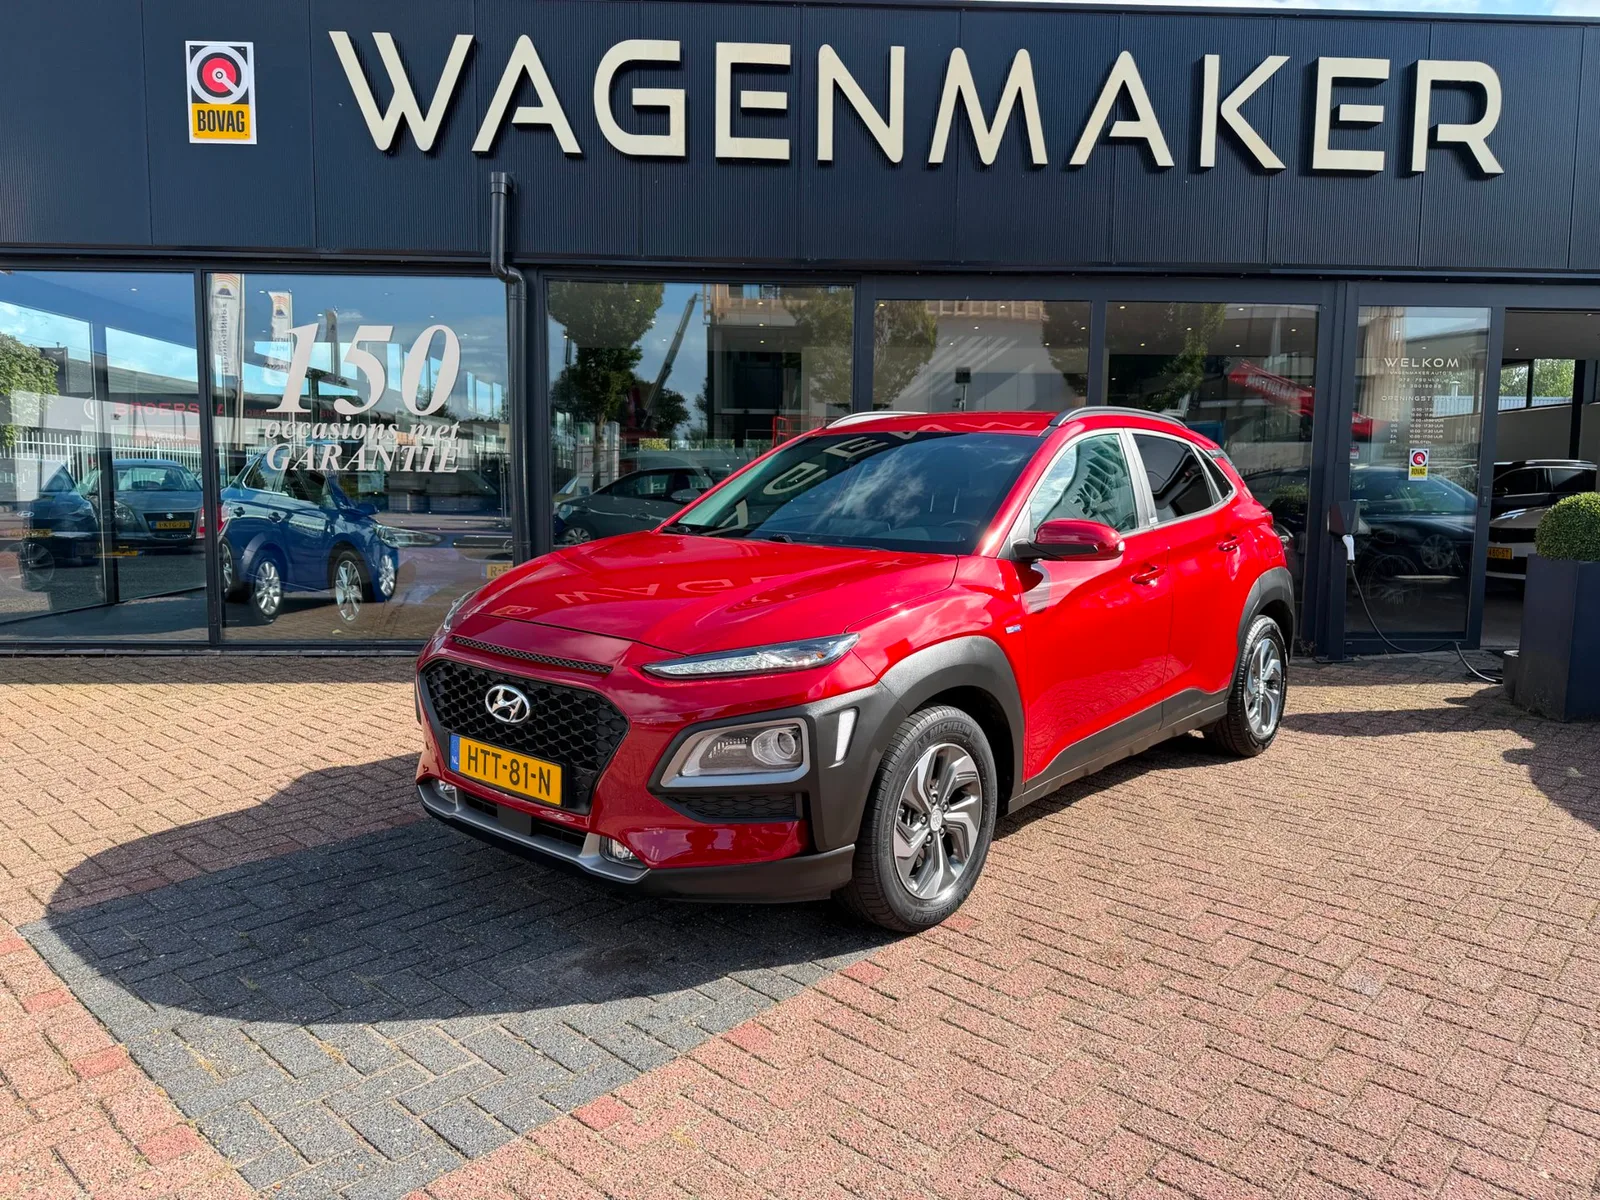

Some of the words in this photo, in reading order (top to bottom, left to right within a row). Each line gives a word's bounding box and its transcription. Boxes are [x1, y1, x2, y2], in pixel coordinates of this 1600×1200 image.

[328, 31, 1505, 174] WAGENMAKER
[197, 109, 245, 133] BOVAG
[266, 322, 461, 416] 150
[1384, 358, 1459, 368] WELKOM
[265, 416, 399, 440] occasions
[411, 420, 460, 441] met
[266, 443, 461, 473] GARANTIE
[929, 721, 971, 739] MICHELIN
[452, 756, 459, 765] NL
[467, 744, 551, 797] HTT-81-N
